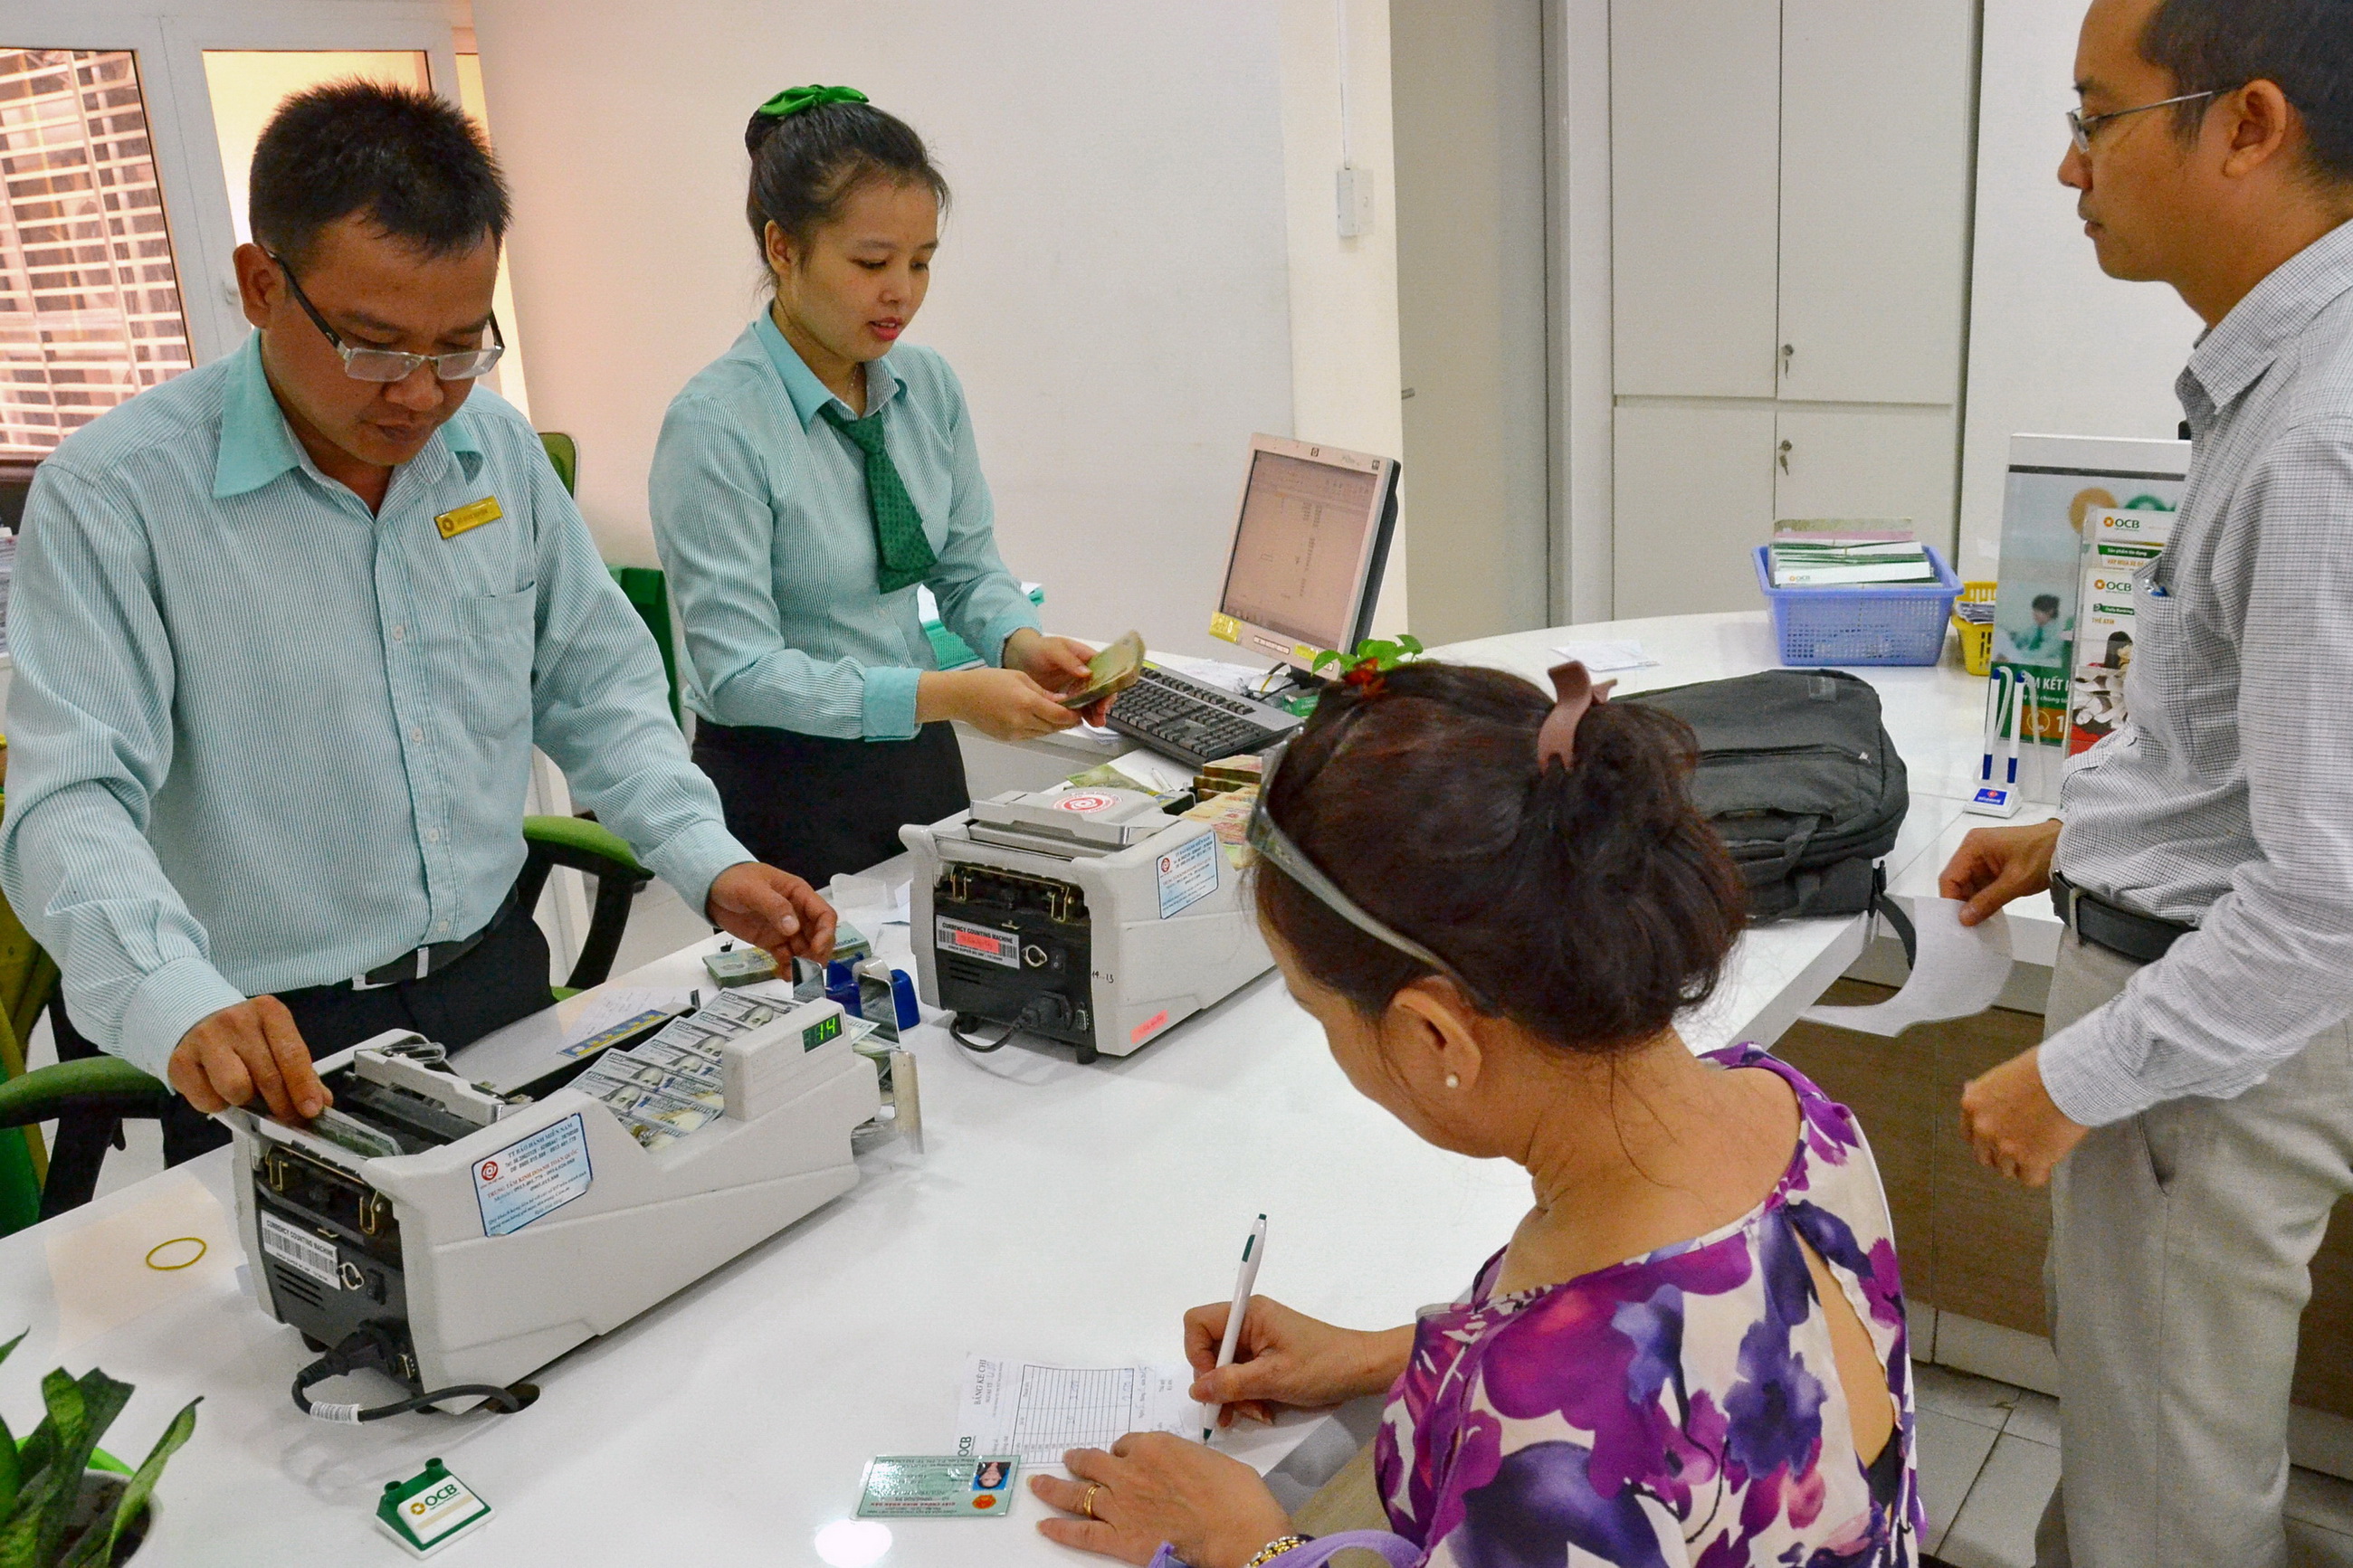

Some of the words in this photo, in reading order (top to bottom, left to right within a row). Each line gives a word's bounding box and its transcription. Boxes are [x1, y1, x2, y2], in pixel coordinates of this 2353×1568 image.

[2115, 518, 2139, 528] OCB
[2107, 581, 2132, 592] OCB
[957, 1436, 972, 1457] OCB
[424, 1484, 457, 1506] OCB
